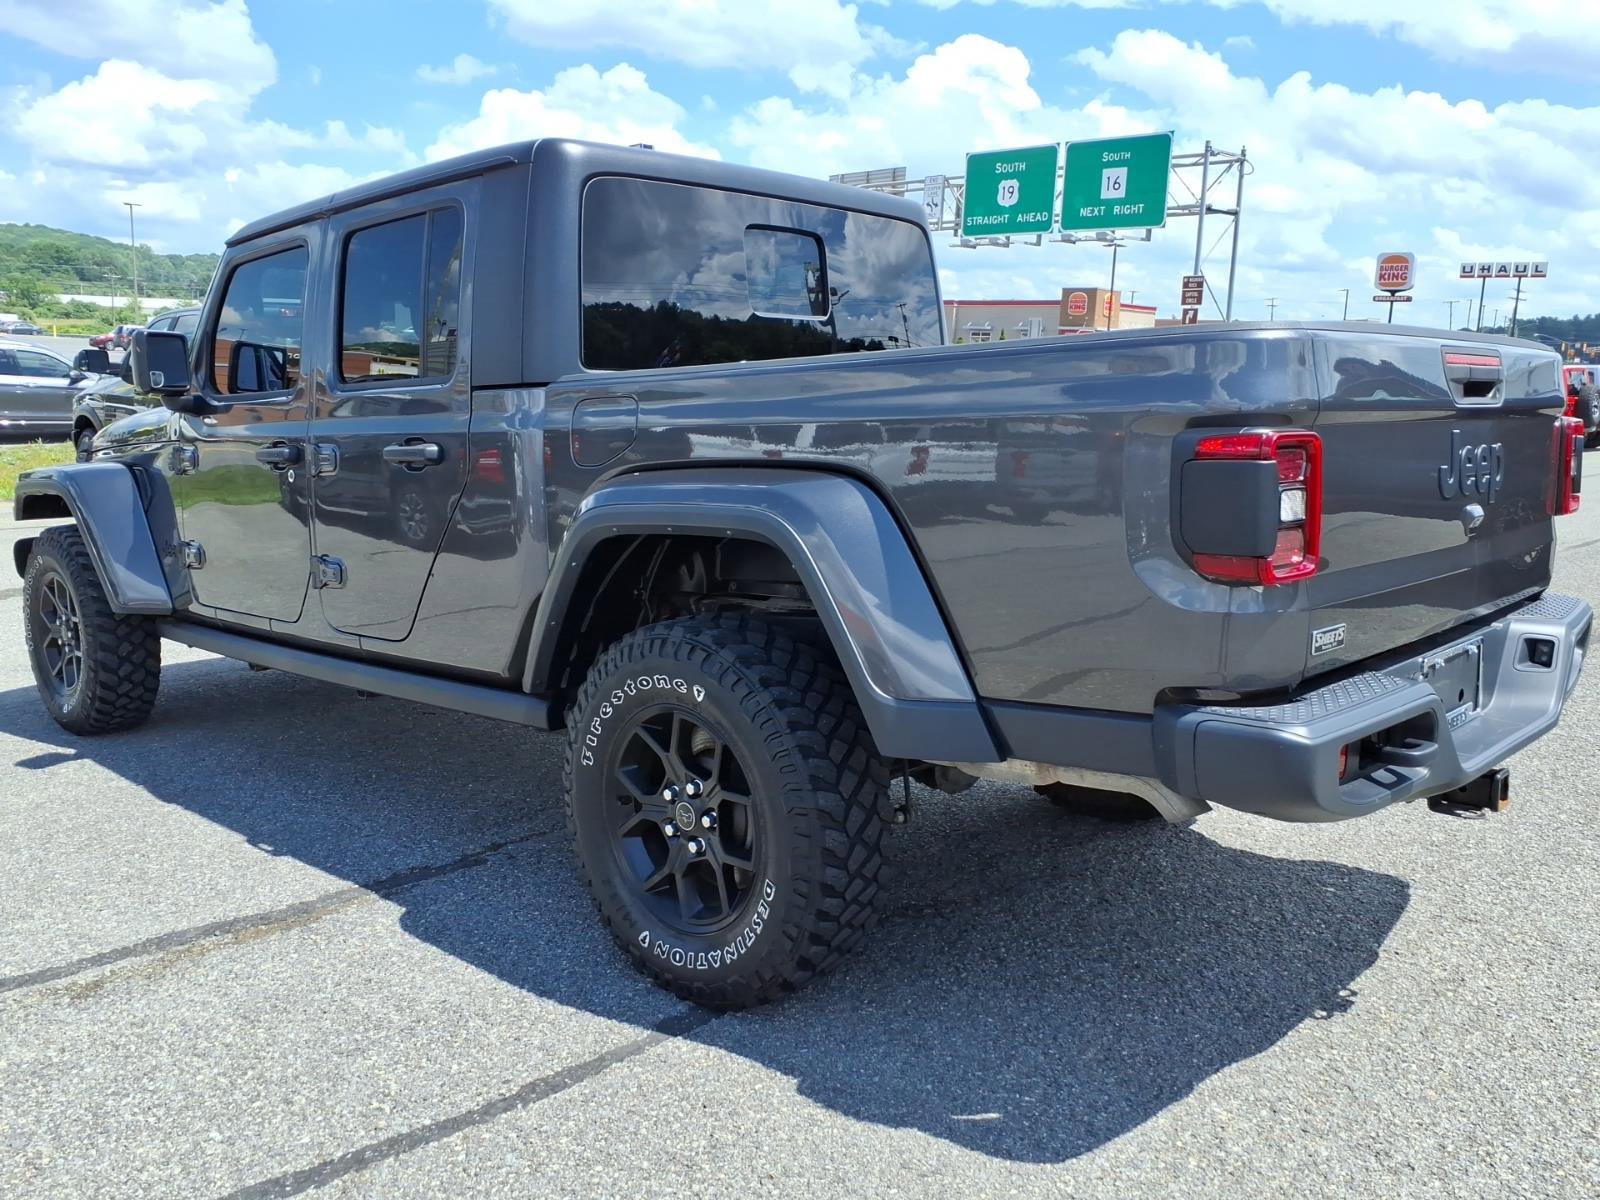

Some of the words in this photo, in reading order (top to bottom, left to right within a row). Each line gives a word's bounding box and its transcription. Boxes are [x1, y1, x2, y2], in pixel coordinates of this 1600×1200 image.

[1101, 151, 1131, 162] SOUTH
[995, 162, 1026, 173] SOUTH
[1106, 175, 1121, 191] 16
[1002, 185, 1015, 201] 19
[1080, 206, 1106, 217] NEXT
[1113, 203, 1144, 215] RIGHT
[966, 214, 1009, 226] STRAIGHT
[1016, 212, 1048, 223] AHEAD
[1379, 264, 1409, 272] BURGER
[1378, 271, 1408, 281] KING
[1438, 429, 1503, 504] Jeep
[653, 879, 776, 970] DESTINATION
